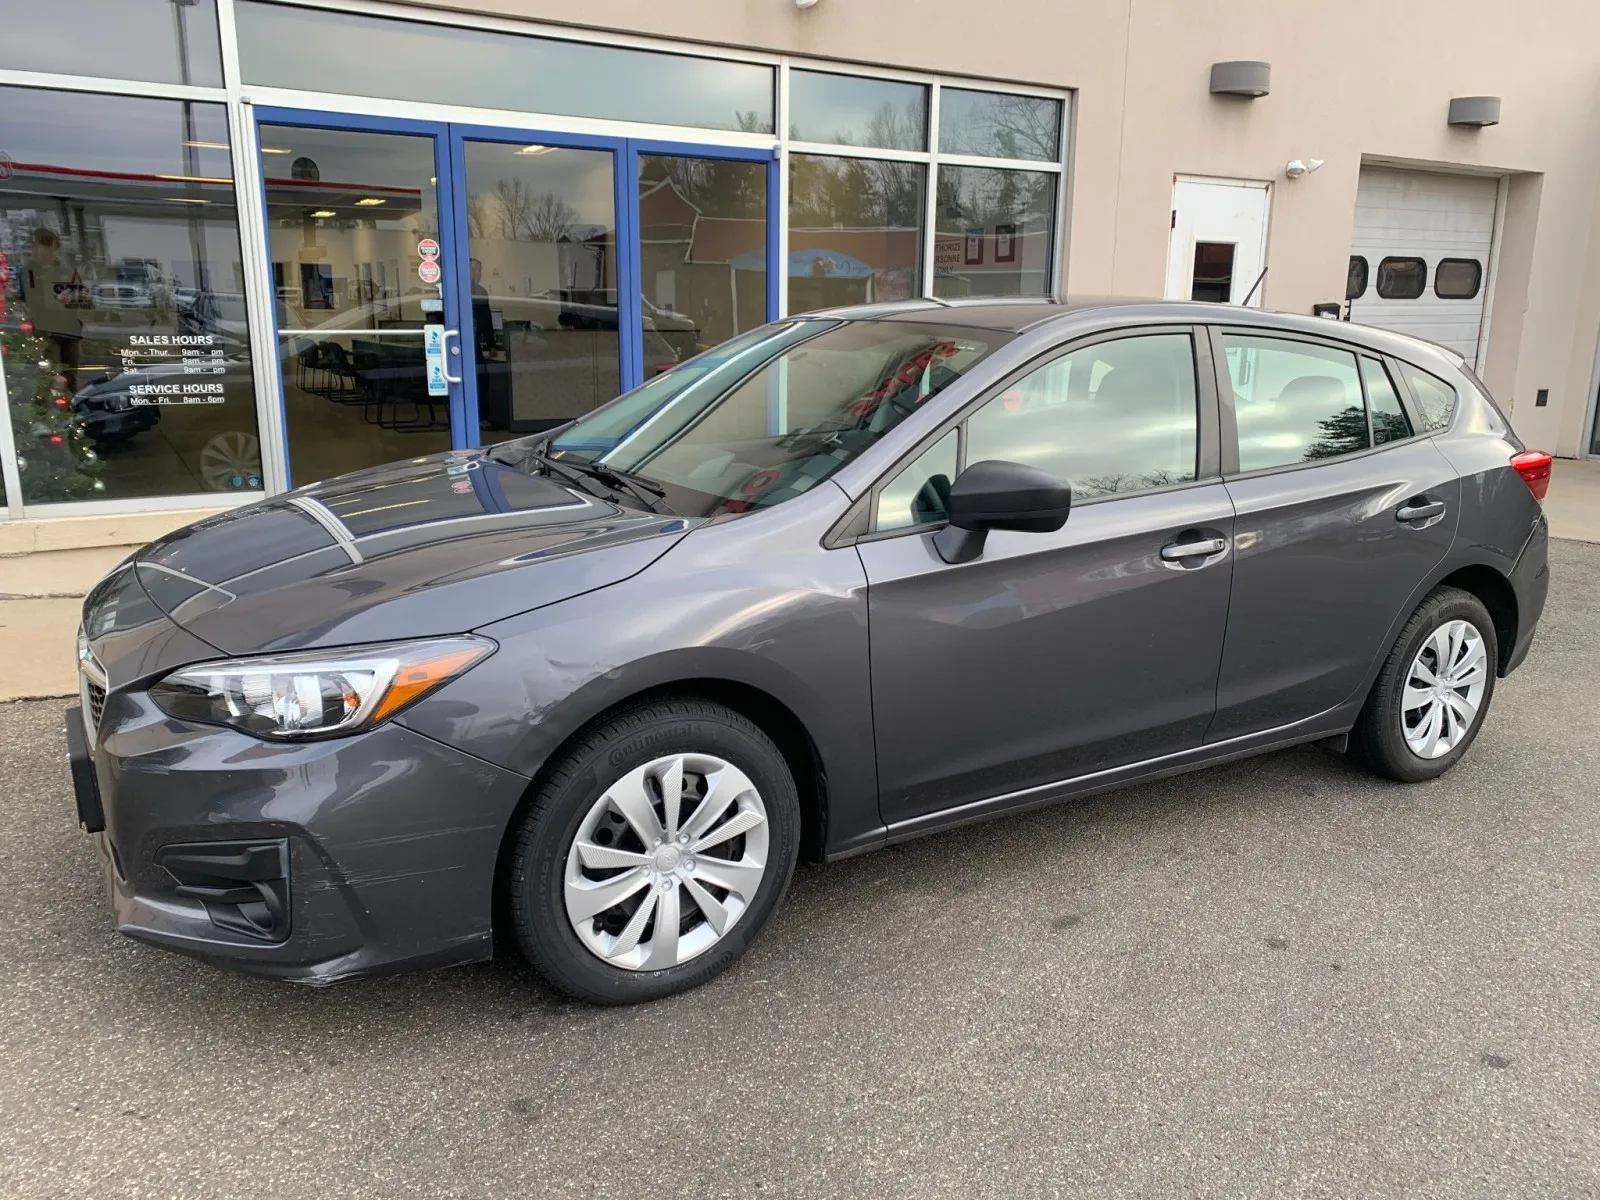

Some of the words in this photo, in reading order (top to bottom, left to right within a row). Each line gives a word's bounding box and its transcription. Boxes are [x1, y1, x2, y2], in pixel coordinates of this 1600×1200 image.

[129, 335, 169, 345] SALES
[171, 335, 213, 345] HOURS
[120, 348, 141, 356] Mon.
[149, 348, 171, 356] Thur.
[181, 348, 200, 356] 9am
[211, 349, 224, 357] pm
[211, 358, 224, 366] pm
[183, 366, 201, 374] 9am
[212, 367, 226, 375] pm
[129, 384, 180, 394] SERVICE
[183, 383, 224, 393] HOURS
[130, 397, 151, 405] Mon.
[158, 396, 171, 404] Fri.
[183, 396, 201, 404] 8am
[207, 396, 225, 405] 6pm
[607, 723, 692, 768] Continental
